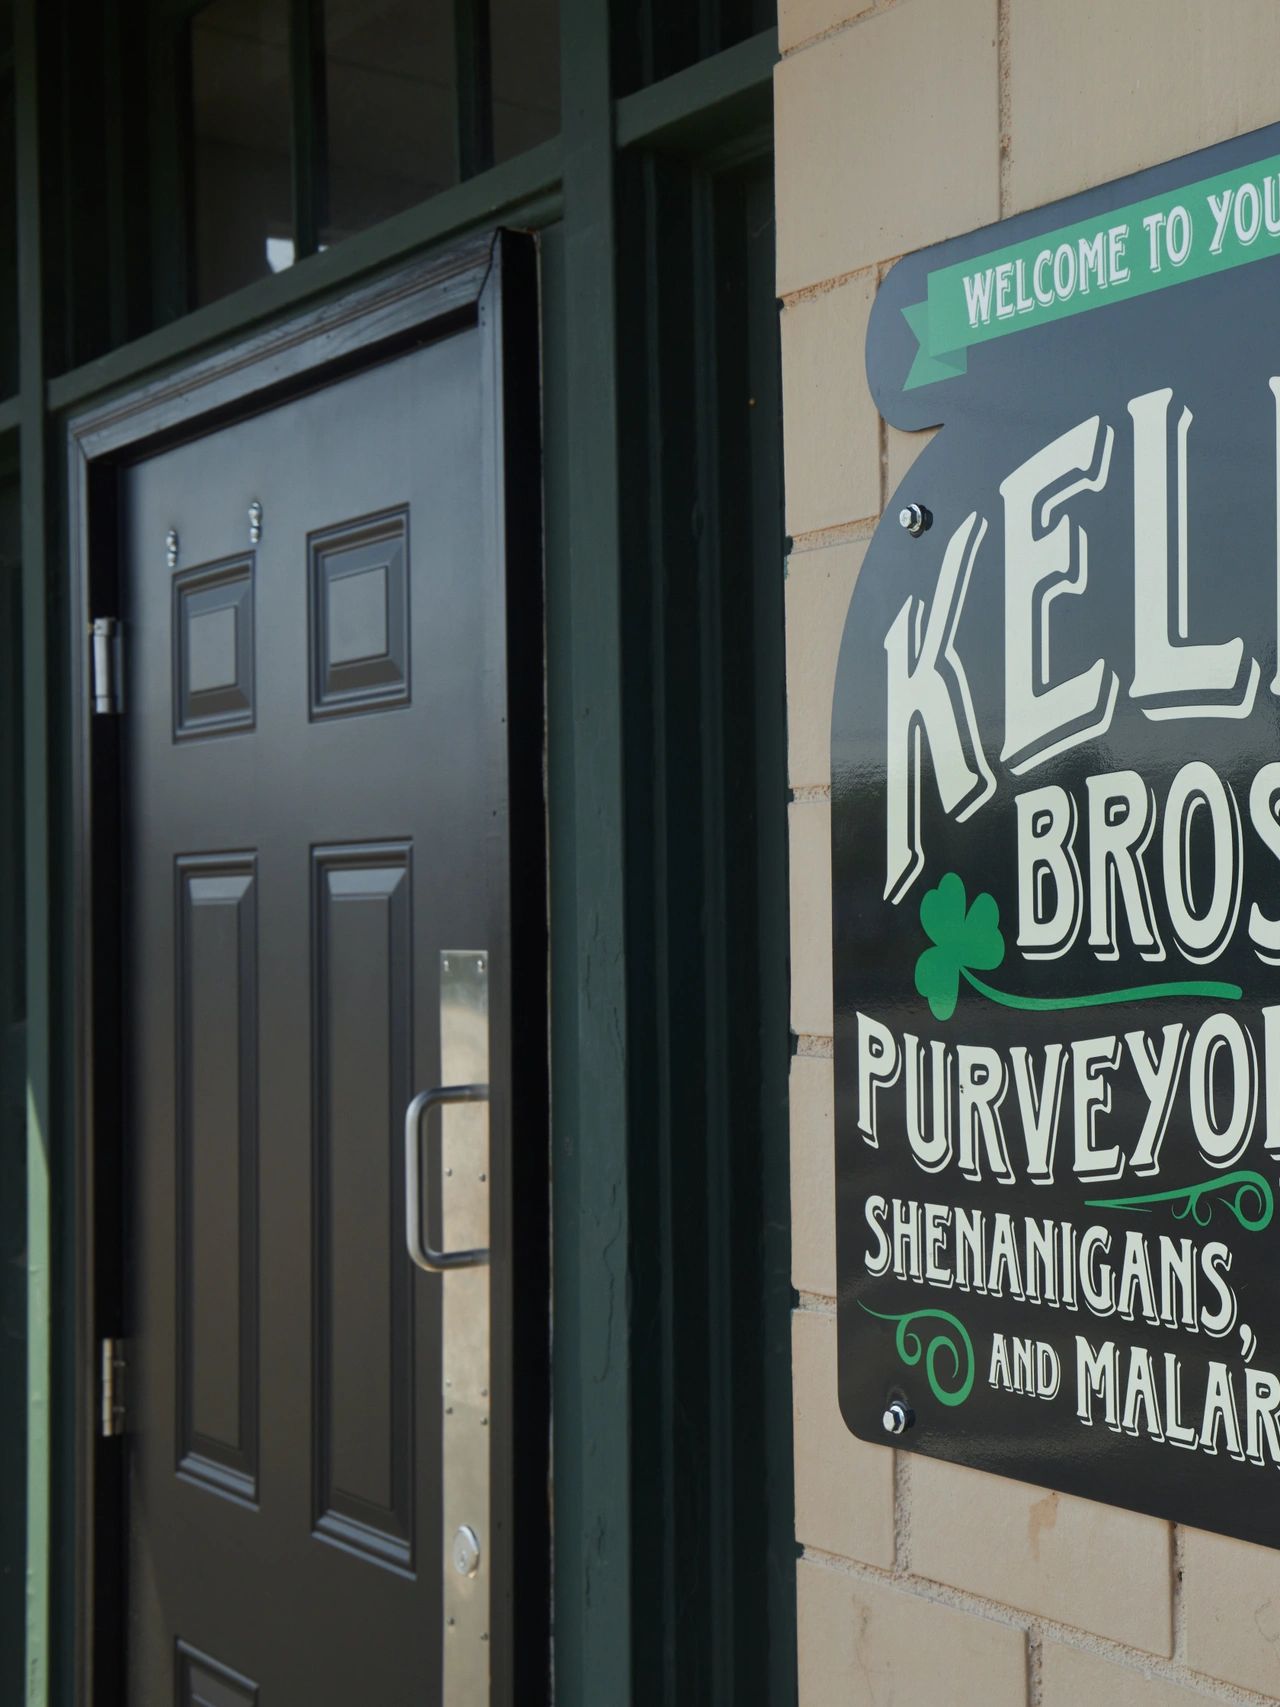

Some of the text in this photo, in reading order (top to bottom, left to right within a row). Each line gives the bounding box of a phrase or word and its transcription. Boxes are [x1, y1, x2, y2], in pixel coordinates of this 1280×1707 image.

[963, 224, 1130, 328] WELCOME
[1143, 206, 1192, 272] TO
[865, 1196, 1256, 1362] SHENANIGANS,
[989, 1333, 1060, 1400] AND
